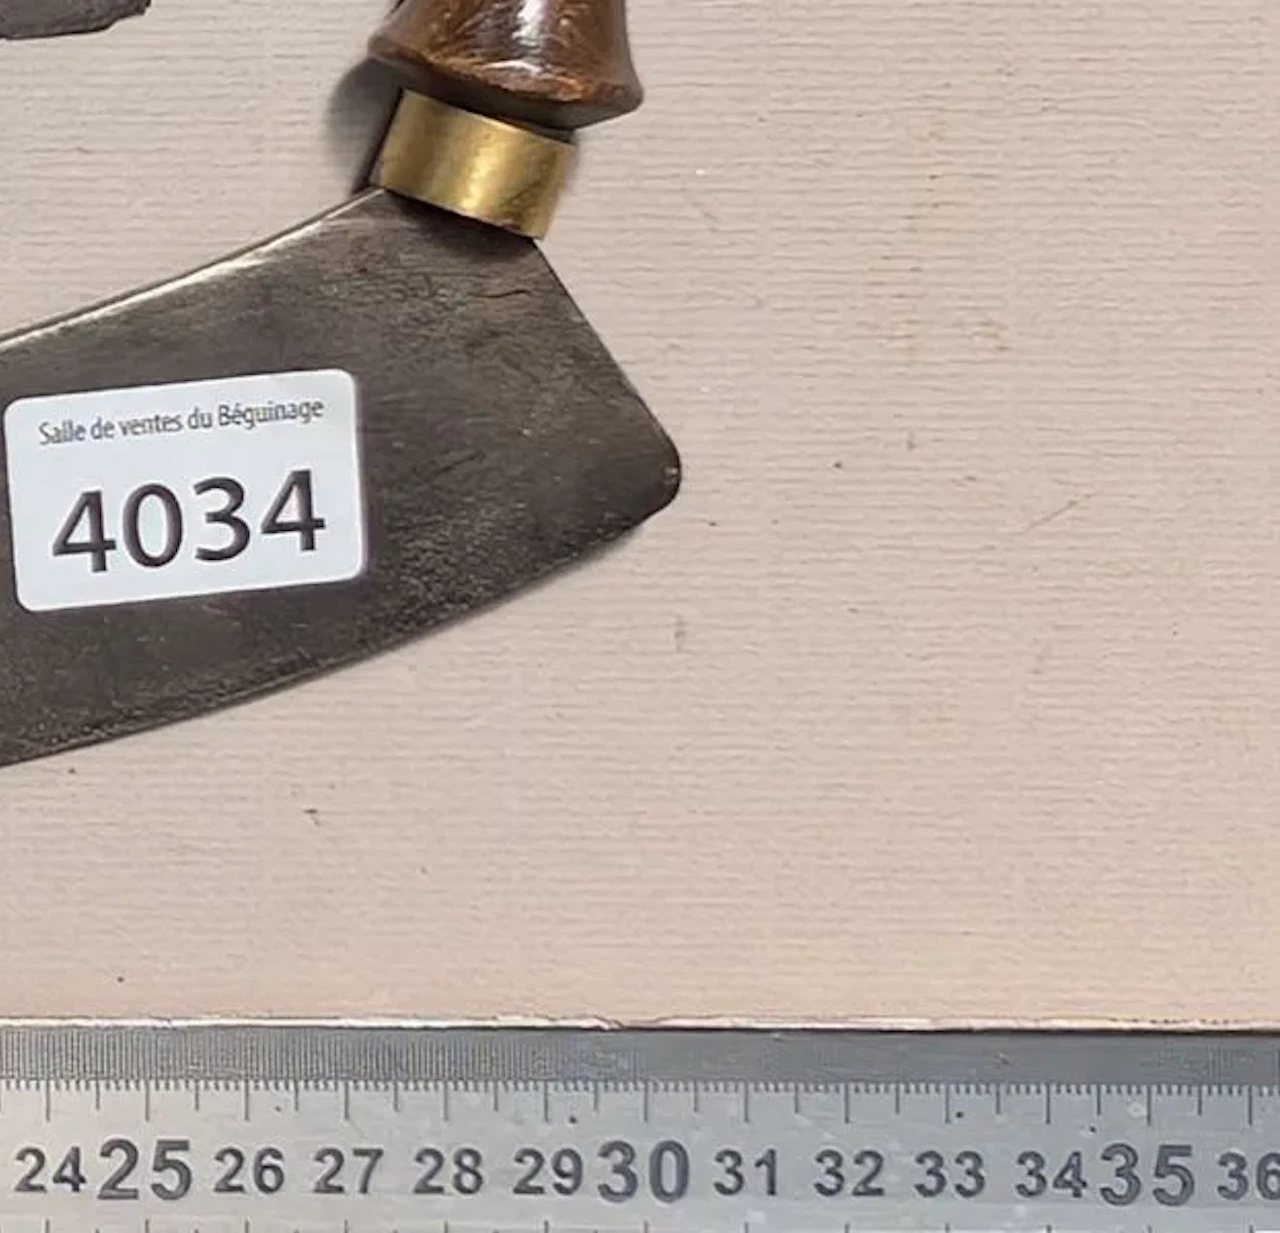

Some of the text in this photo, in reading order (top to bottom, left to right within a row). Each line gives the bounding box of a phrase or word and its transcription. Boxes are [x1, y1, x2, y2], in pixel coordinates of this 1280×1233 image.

[38, 399, 324, 445] Salle de ventes du Béguinage
[52, 469, 326, 572] 4034
[14, 1147, 87, 1194] 24
[97, 1139, 192, 1201] 25
[213, 1147, 285, 1194] 26
[313, 1148, 384, 1195] 27
[413, 1148, 484, 1195] 28
[513, 1148, 583, 1196] 29
[598, 1141, 689, 1203] 30
[714, 1149, 777, 1196] 31
[814, 1150, 885, 1197] 32
[914, 1151, 985, 1198] 33
[1015, 1151, 1088, 1198] 34
[1100, 1143, 1194, 1206] 35
[1217, 1153, 1280, 1200] 36
